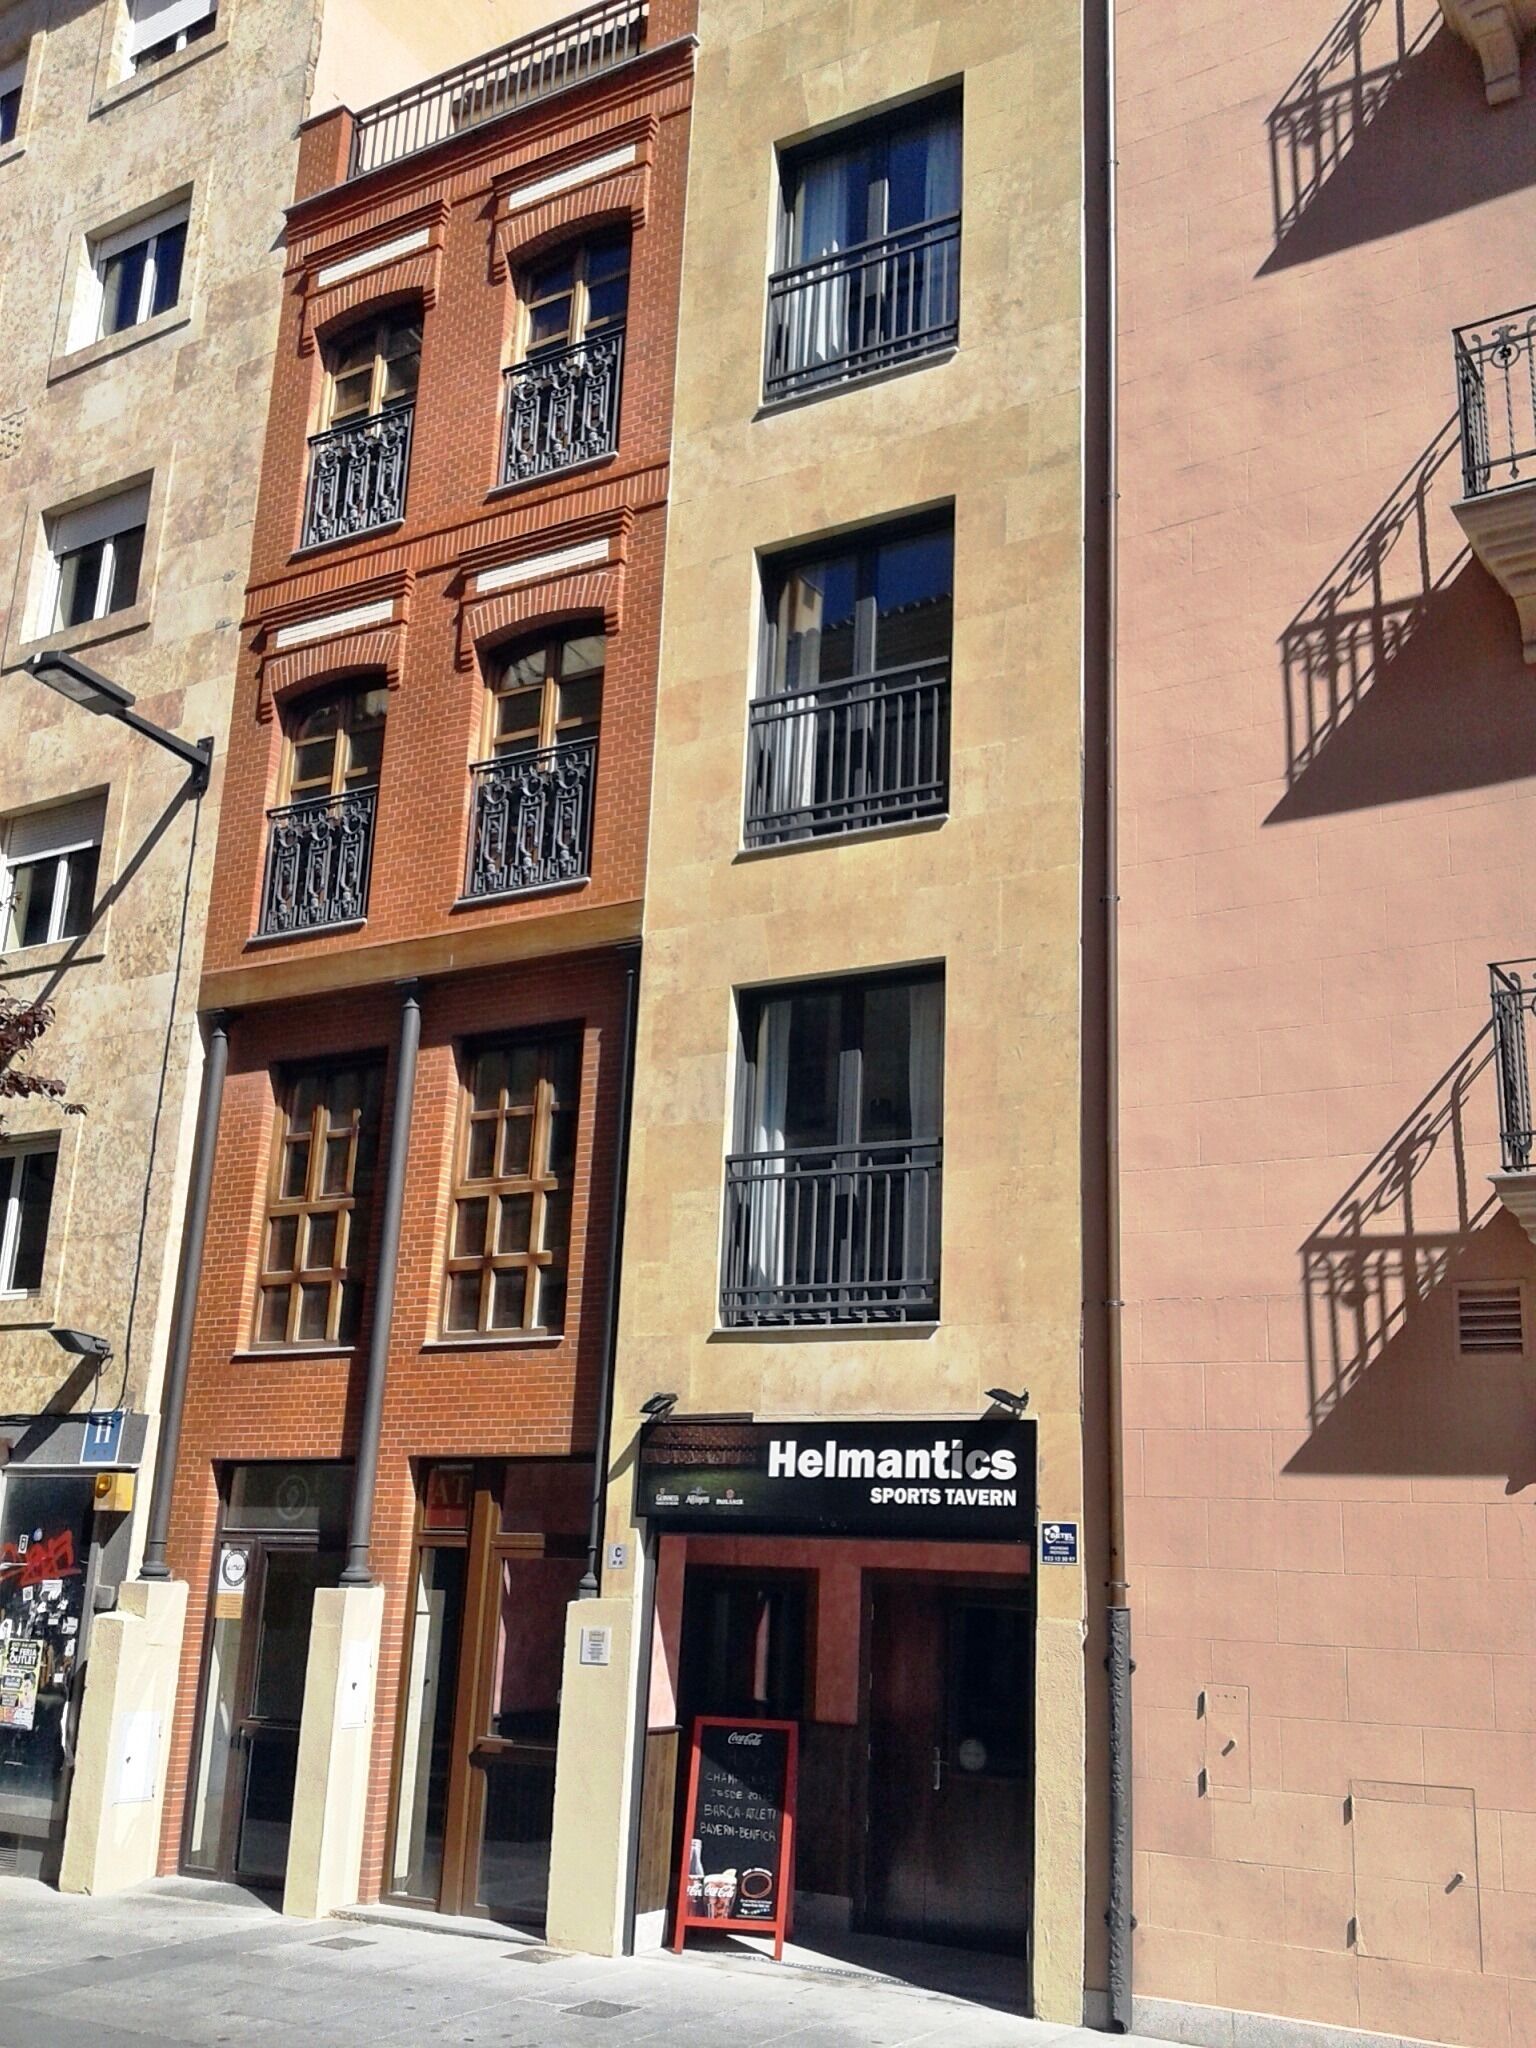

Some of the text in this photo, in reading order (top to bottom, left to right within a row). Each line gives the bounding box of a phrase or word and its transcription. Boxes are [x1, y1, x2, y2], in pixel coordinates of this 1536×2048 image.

[94, 1416, 111, 1444] H
[768, 1440, 1018, 1481] Helmantics
[870, 1487, 1017, 1507] SPORTS TAVERN
[614, 1547, 623, 1558] C
[9, 1655, 37, 1665] OUTLET
